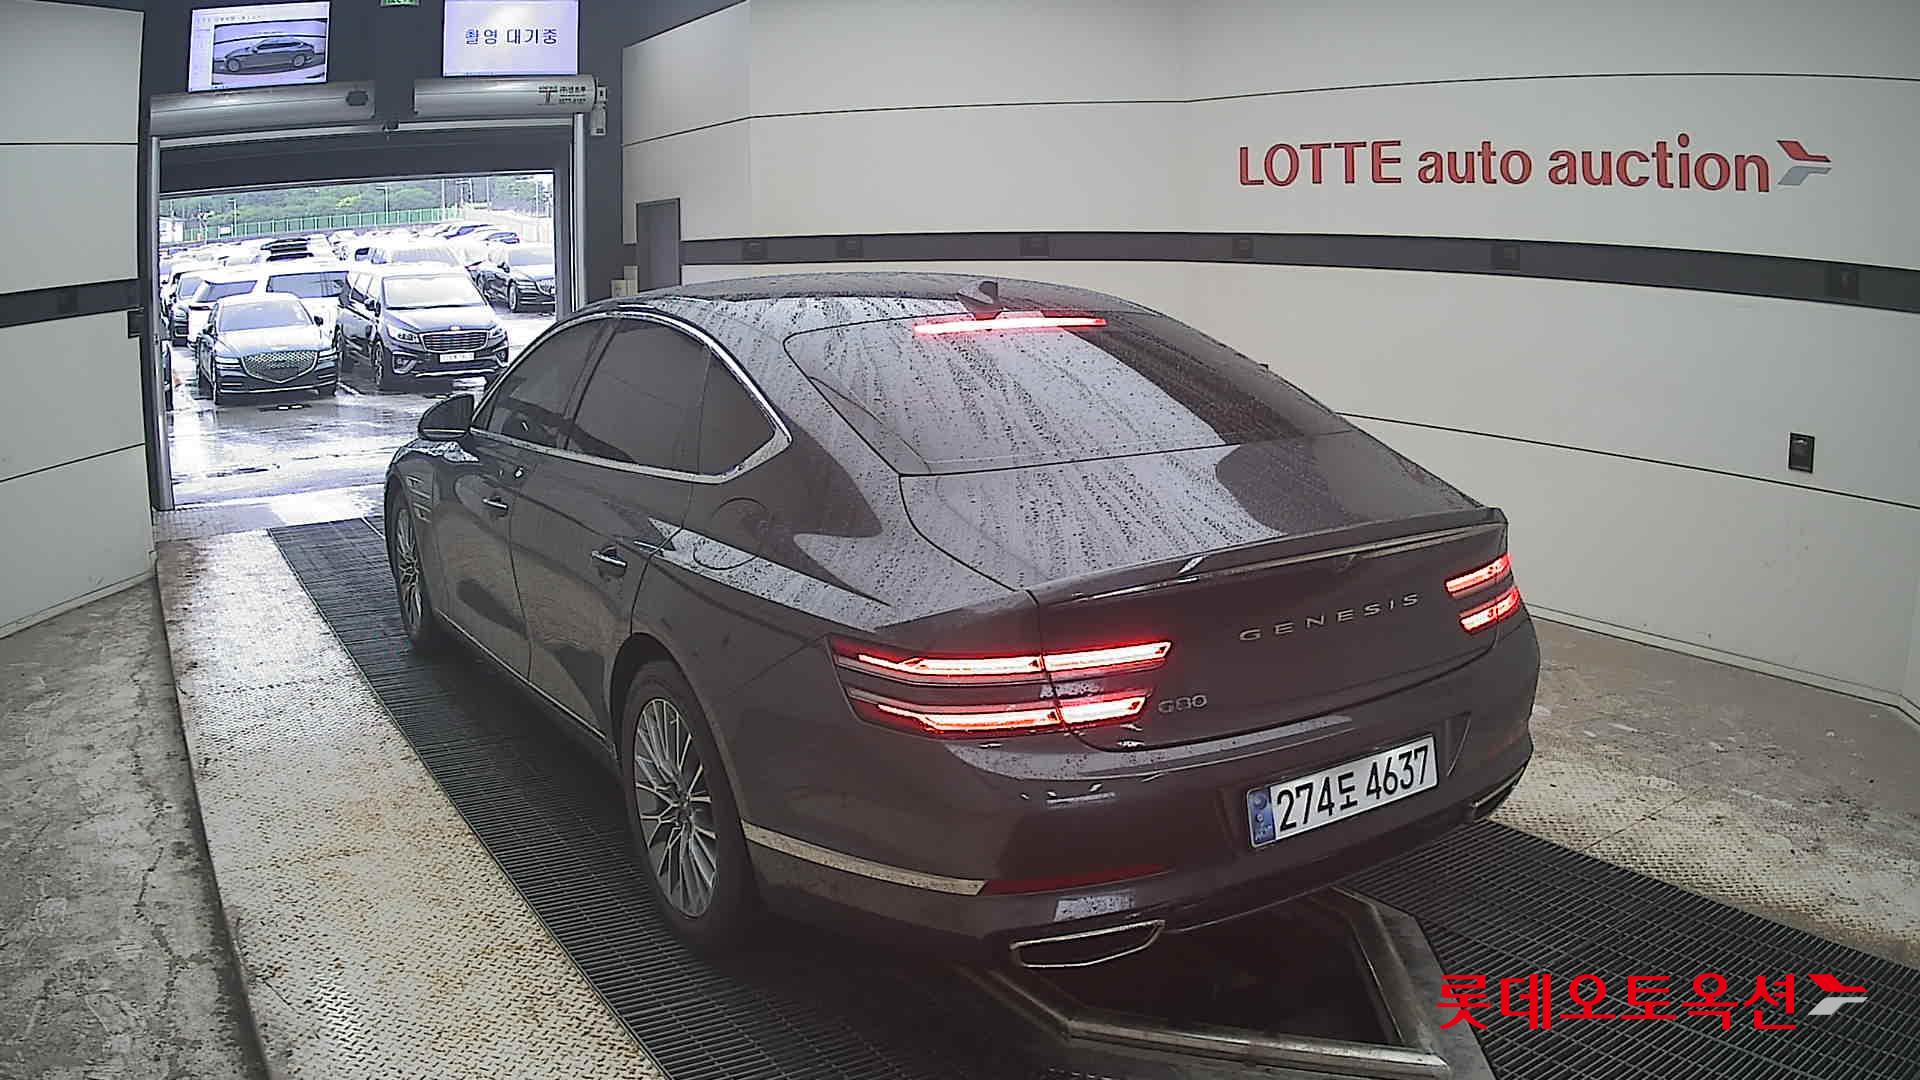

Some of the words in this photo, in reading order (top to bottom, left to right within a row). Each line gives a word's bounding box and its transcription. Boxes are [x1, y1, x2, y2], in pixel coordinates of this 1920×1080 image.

[465, 28, 498, 45] 촬영
[506, 28, 558, 45] 대기중
[1239, 140, 1402, 186] LOTTE
[1418, 141, 1532, 184] auto
[1548, 133, 1770, 193] auction
[1239, 593, 1420, 642] GENESIS
[1158, 694, 1208, 714] G80
[1276, 771, 1358, 832] 274도
[1366, 745, 1430, 800] 4637
